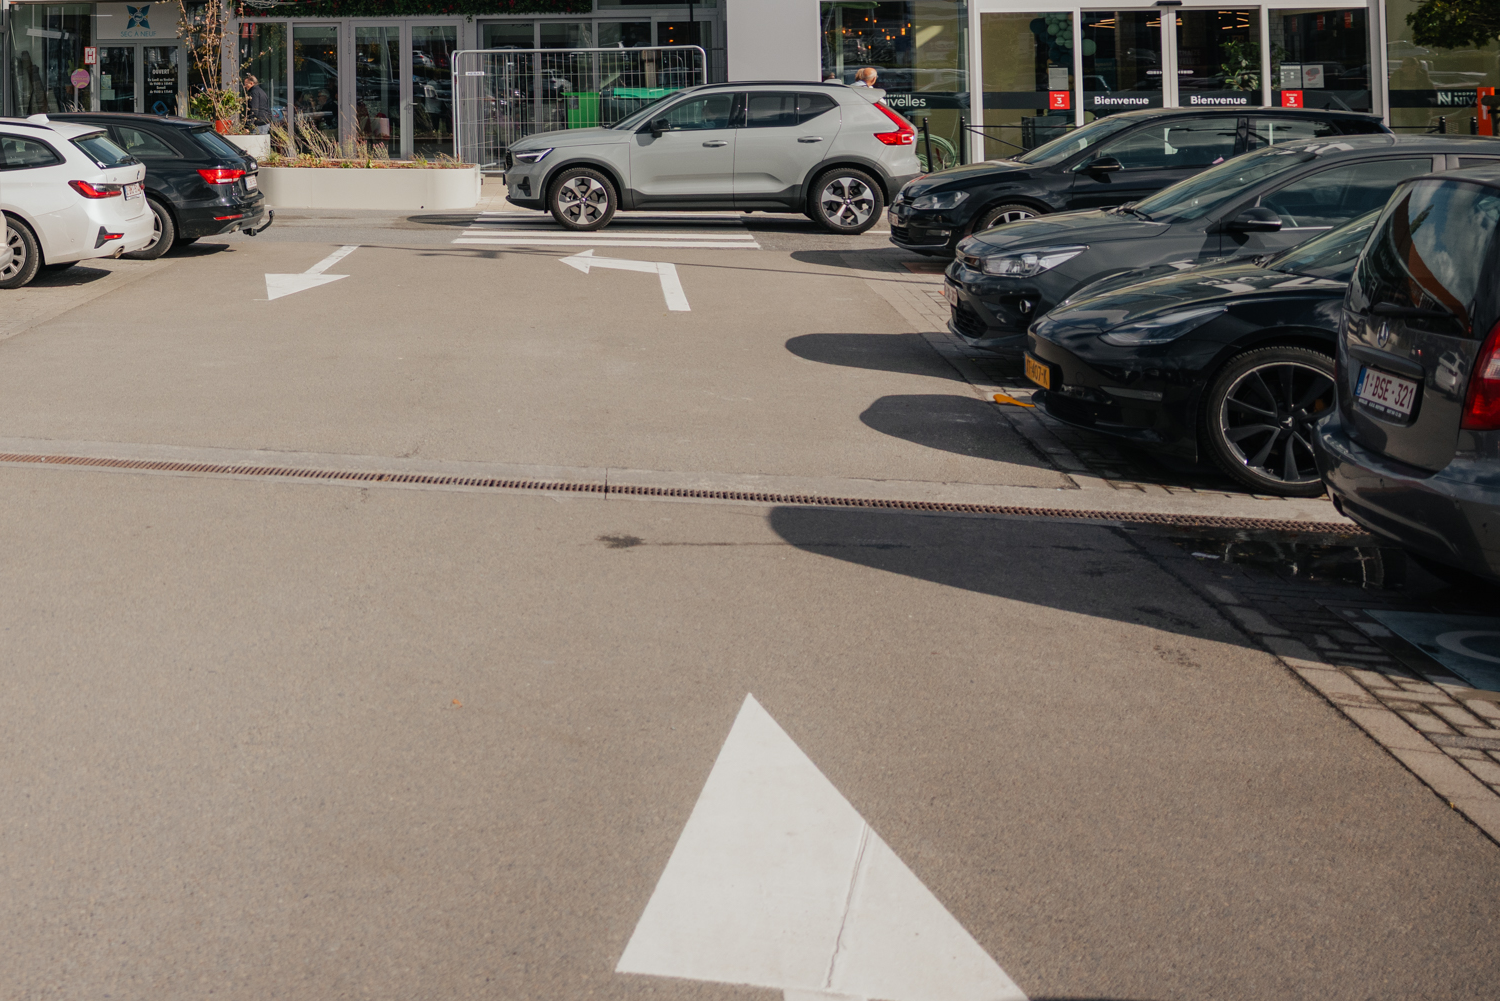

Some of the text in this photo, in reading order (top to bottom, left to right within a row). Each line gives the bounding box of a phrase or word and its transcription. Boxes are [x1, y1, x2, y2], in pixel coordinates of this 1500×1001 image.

[120, 30, 133, 38] SEC
[87, 49, 94, 61] H
[886, 94, 927, 107] ivelles
[1094, 96, 1150, 105] Bienvenue
[1190, 95, 1247, 105] Bienvenue
[1288, 96, 1295, 104] 3
